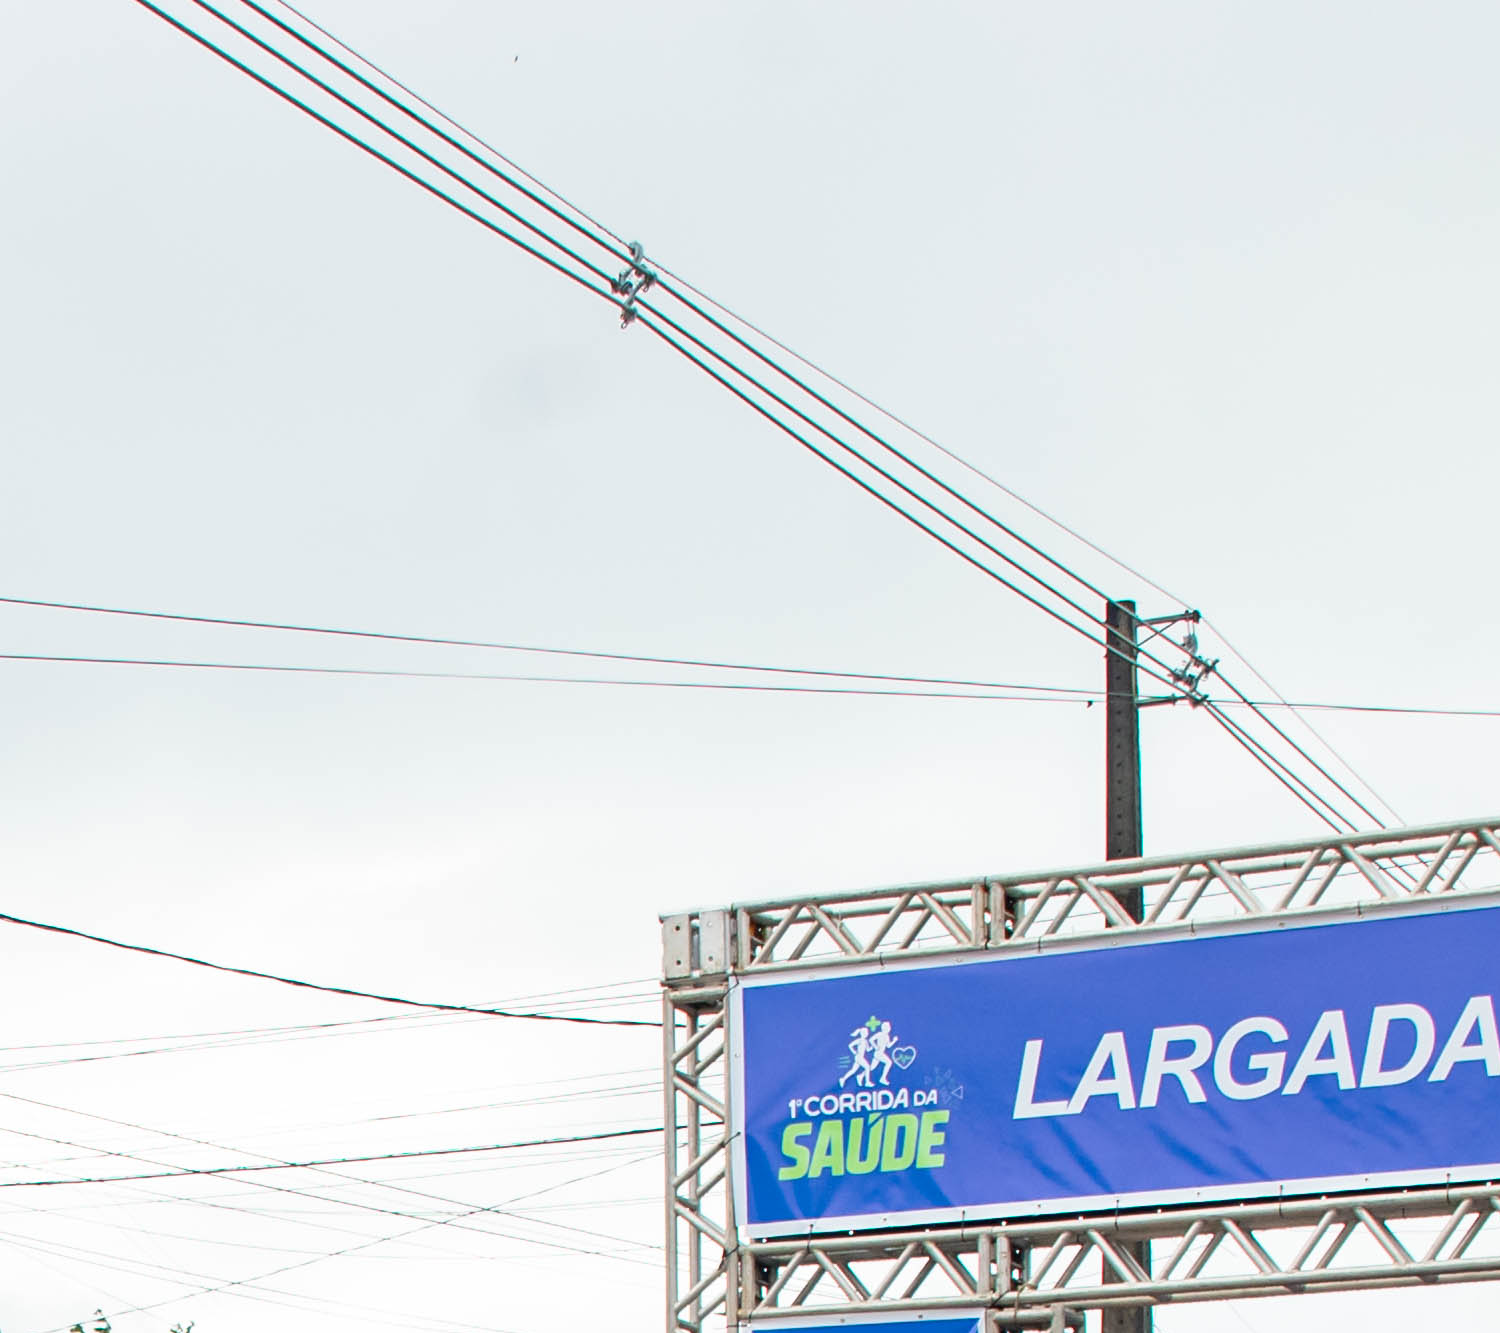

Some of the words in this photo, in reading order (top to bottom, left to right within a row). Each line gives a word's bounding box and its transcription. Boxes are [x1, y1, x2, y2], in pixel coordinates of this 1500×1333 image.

[804, 1087, 909, 1117] CORRIDA
[913, 1089, 939, 1107] DA
[778, 1110, 950, 1181] SAÚDE
